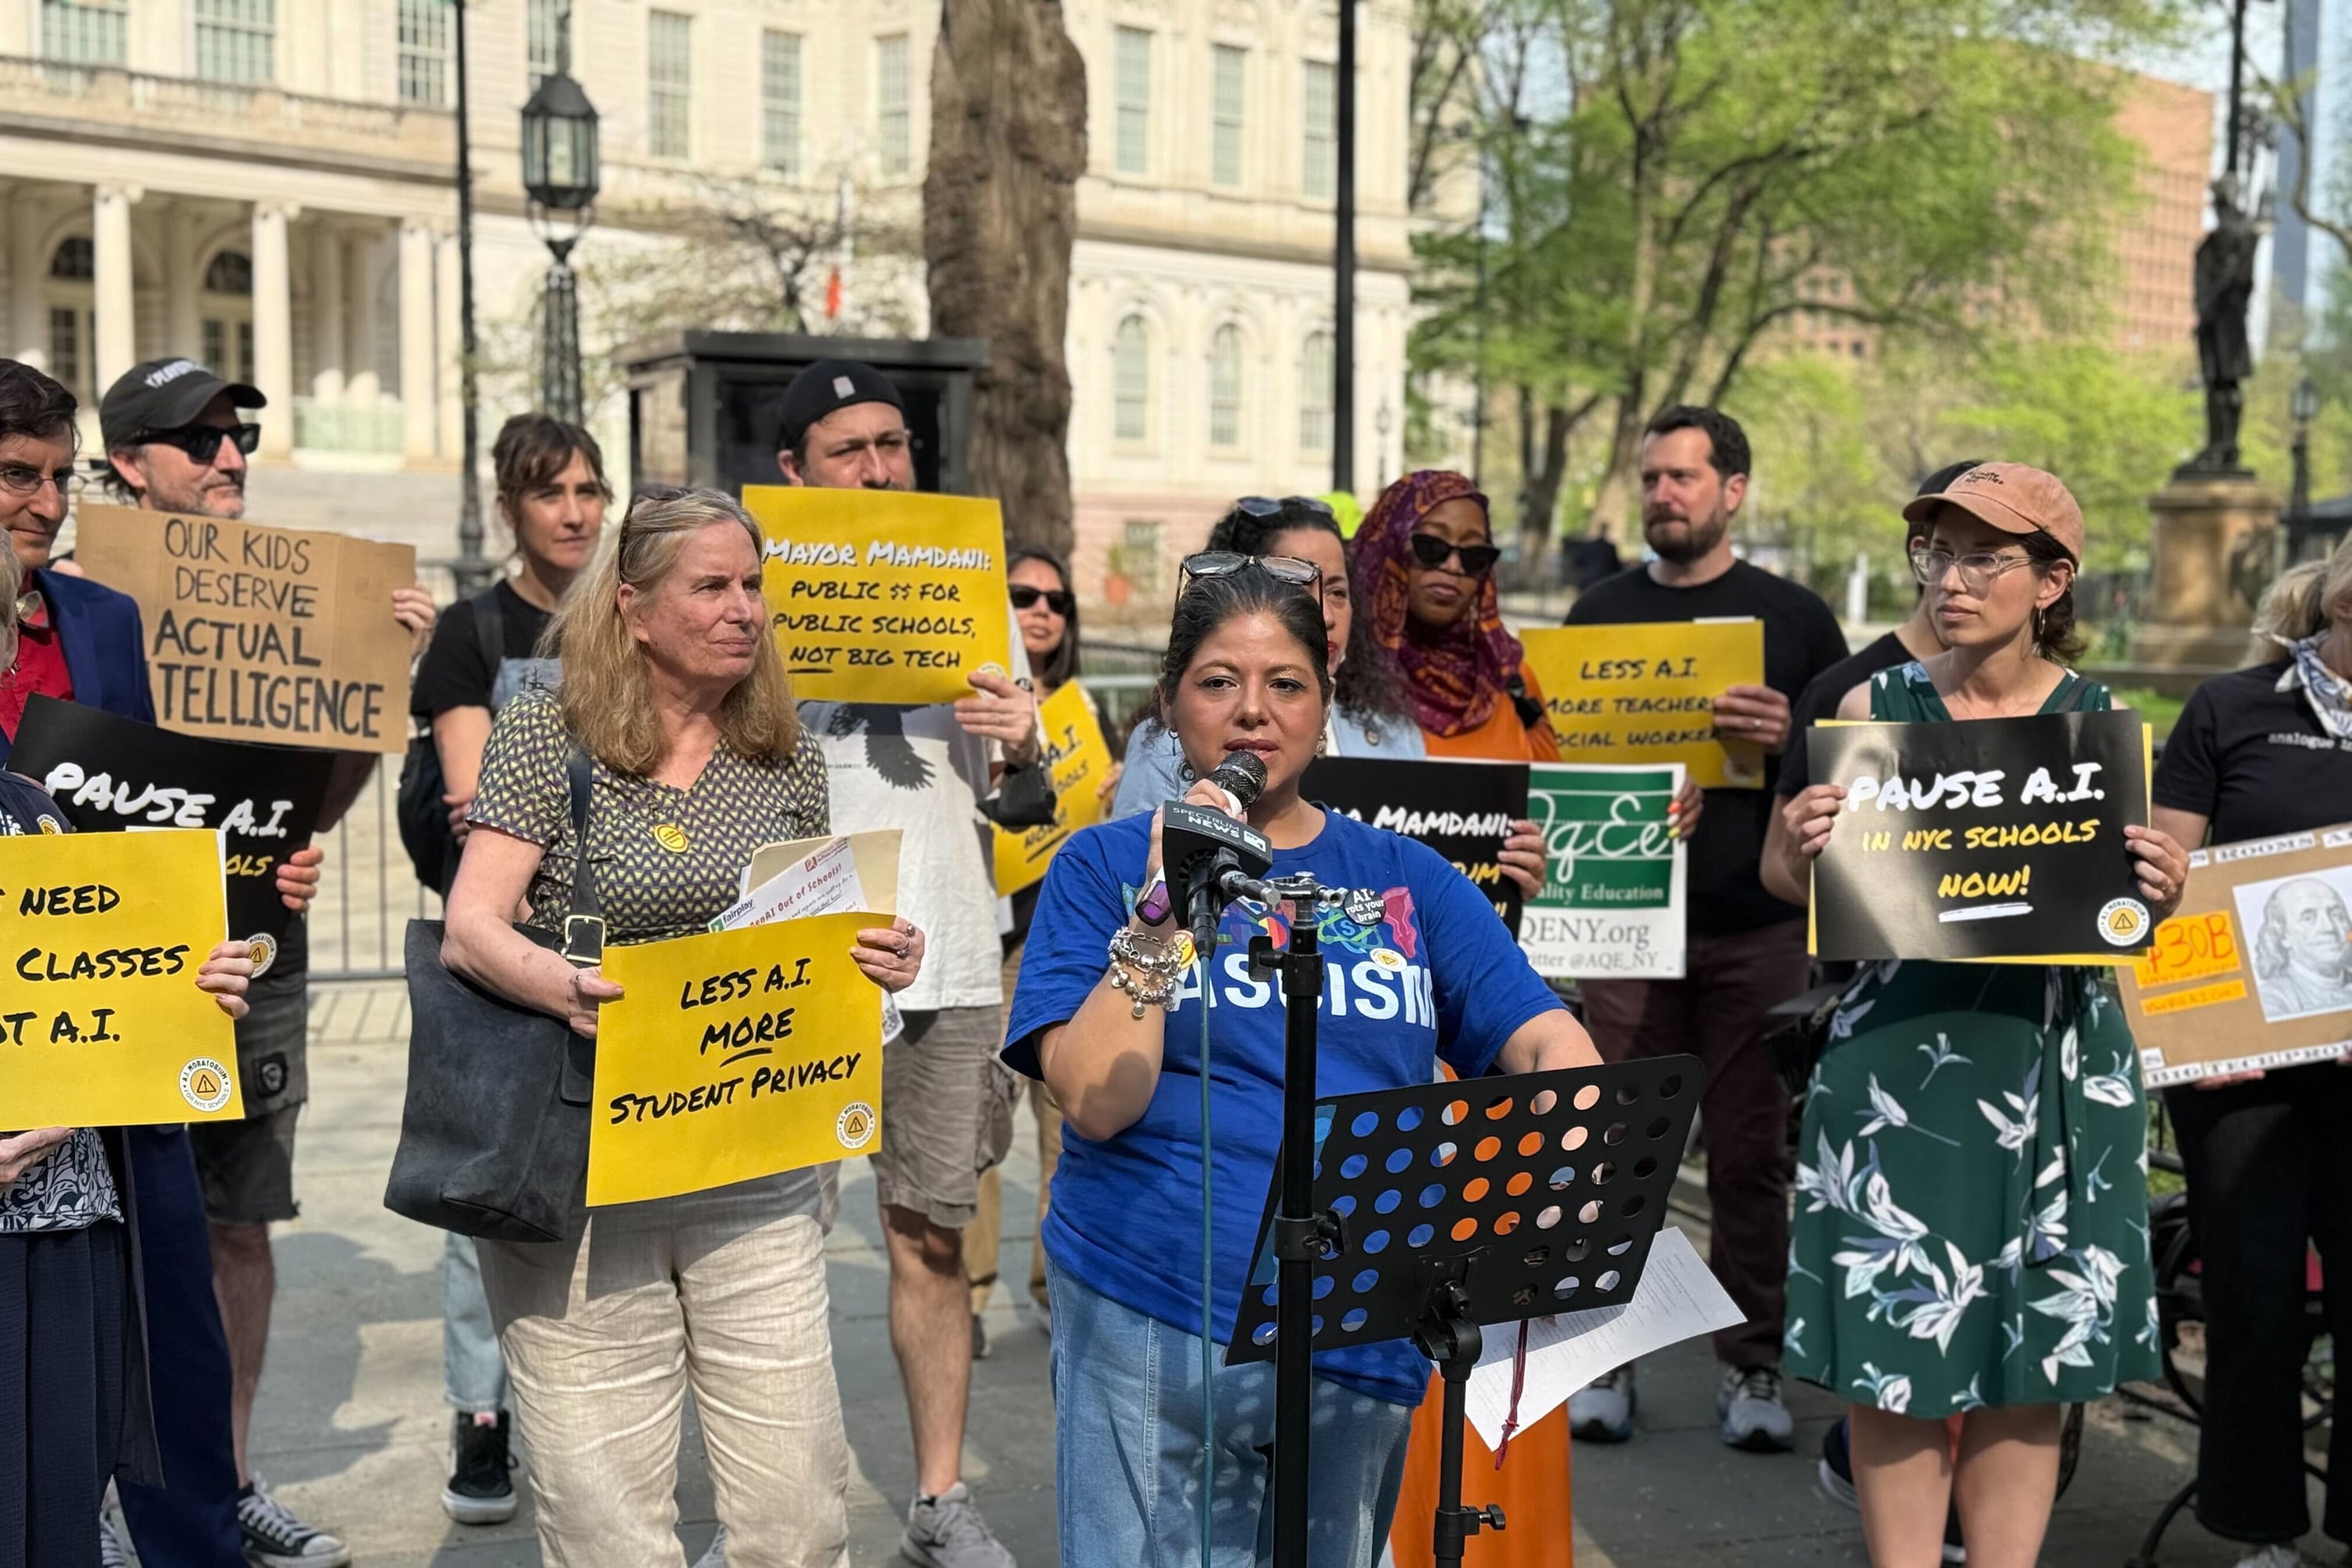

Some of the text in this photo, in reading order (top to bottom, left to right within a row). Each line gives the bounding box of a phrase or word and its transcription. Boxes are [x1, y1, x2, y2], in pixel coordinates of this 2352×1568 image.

[165, 518, 311, 575] OUR KIDS
[762, 537, 992, 572] MAYOR MAMDANI:
[175, 565, 319, 618] DESERVE
[791, 580, 961, 602] PUBLIC $$ FOR
[152, 608, 322, 668] ACTUAL
[772, 612, 977, 639] PUBLIC SCHOOLS,
[789, 646, 960, 669] NOT BIG TECH
[1580, 657, 1698, 681] LESS A.I.
[145, 659, 385, 739] TELLIGENCE
[1613, 696, 1715, 714] TEACHER
[1555, 731, 1616, 748] OCIAL
[2267, 731, 2336, 750] analogue
[45, 762, 216, 829] PAUSE
[220, 798, 295, 840] A.I.
[1846, 761, 2105, 813] PAUSE A.I.
[1172, 807, 1240, 832] SPECTRUM
[1188, 815, 1240, 839] NEWS
[1374, 804, 1514, 837] MAMDANI:
[1862, 818, 2101, 853] IN NYC SCHOOLS
[227, 853, 274, 877] OLS
[1937, 864, 2032, 898] NOW!
[20, 884, 121, 917] NEED
[778, 895, 795, 912] Out
[796, 885, 807, 899] of
[807, 862, 843, 893] Schools!
[1353, 888, 1372, 904] AI
[1536, 881, 1664, 906] ality Education
[722, 898, 754, 924] fairplay
[1345, 899, 1385, 915] rots your
[1357, 910, 1381, 923] brain
[1519, 914, 1650, 951] QENY.org
[16, 944, 191, 982] CLASSES
[1528, 951, 1659, 971] itter @AQE_NY
[680, 957, 812, 1011] LESS A.I.
[1174, 952, 1436, 1030] ASISM
[49, 1008, 121, 1044] A.I.
[699, 1008, 796, 1056] MORE
[187, 1060, 227, 1080] MORATORIUM
[194, 1099, 207, 1109] NYC
[207, 1087, 230, 1109] SCHOOLS
[609, 1052, 862, 1126] STUDENT PRIVACY
